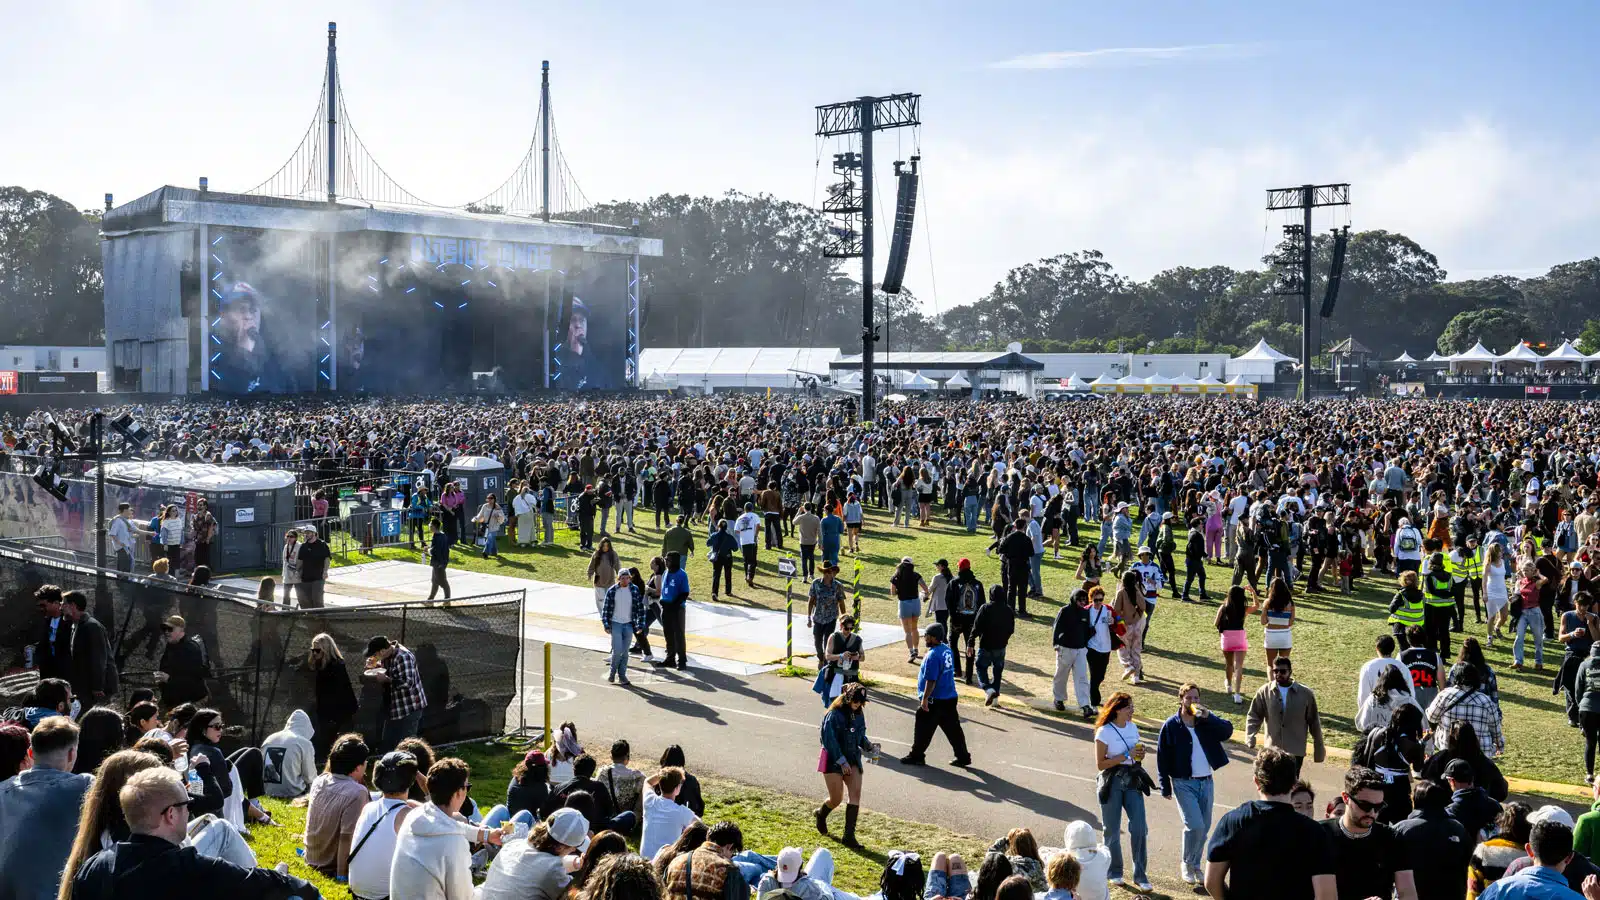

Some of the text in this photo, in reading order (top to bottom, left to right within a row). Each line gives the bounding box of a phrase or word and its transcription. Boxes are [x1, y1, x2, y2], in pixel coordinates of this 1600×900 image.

[410, 236, 489, 265] OUTSIDE
[0, 377, 14, 391] XIT
[1410, 669, 1433, 687] 24
